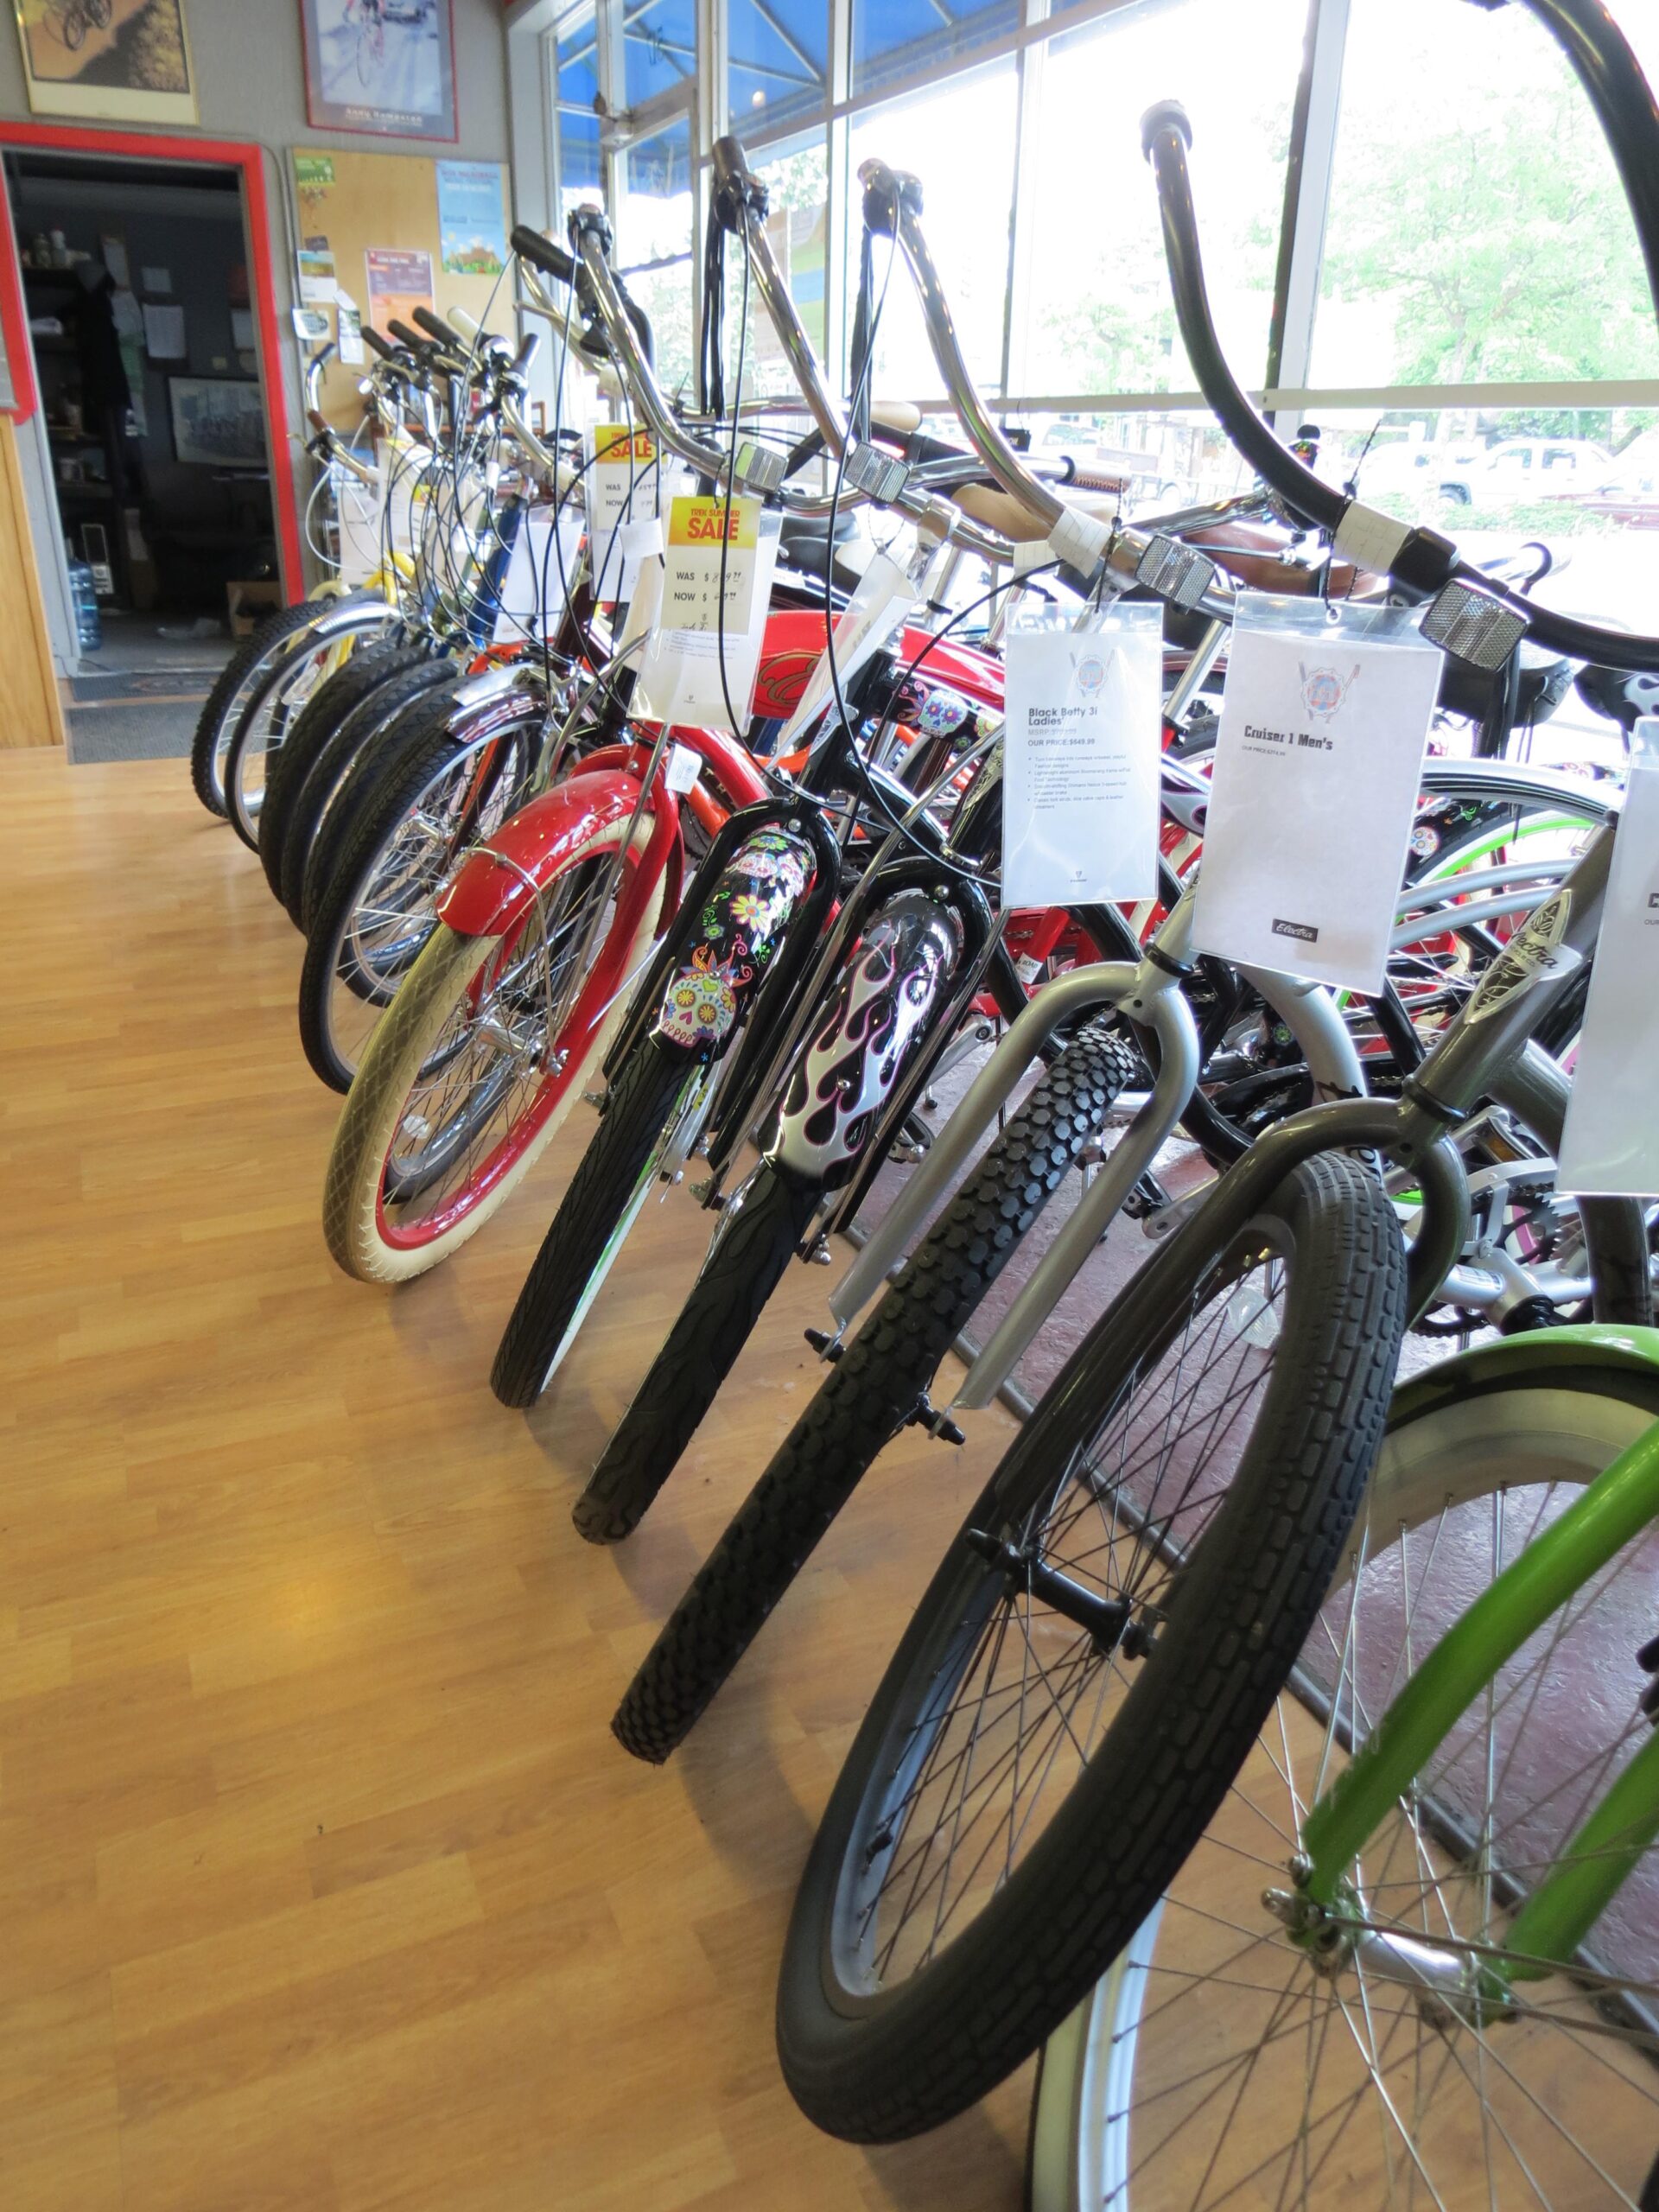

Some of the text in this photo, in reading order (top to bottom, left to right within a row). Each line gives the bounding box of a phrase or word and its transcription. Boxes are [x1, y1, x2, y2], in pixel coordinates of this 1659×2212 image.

[687, 518, 741, 541] SALE
[676, 571, 695, 581] WAS
[674, 592, 696, 601] NOW
[1029, 708, 1058, 717] Black
[1061, 707, 1086, 718] Betty
[1244, 725, 1285, 743] Cruiser
[1297, 733, 1333, 751] Men's
[1275, 923, 1313, 939] Electra
